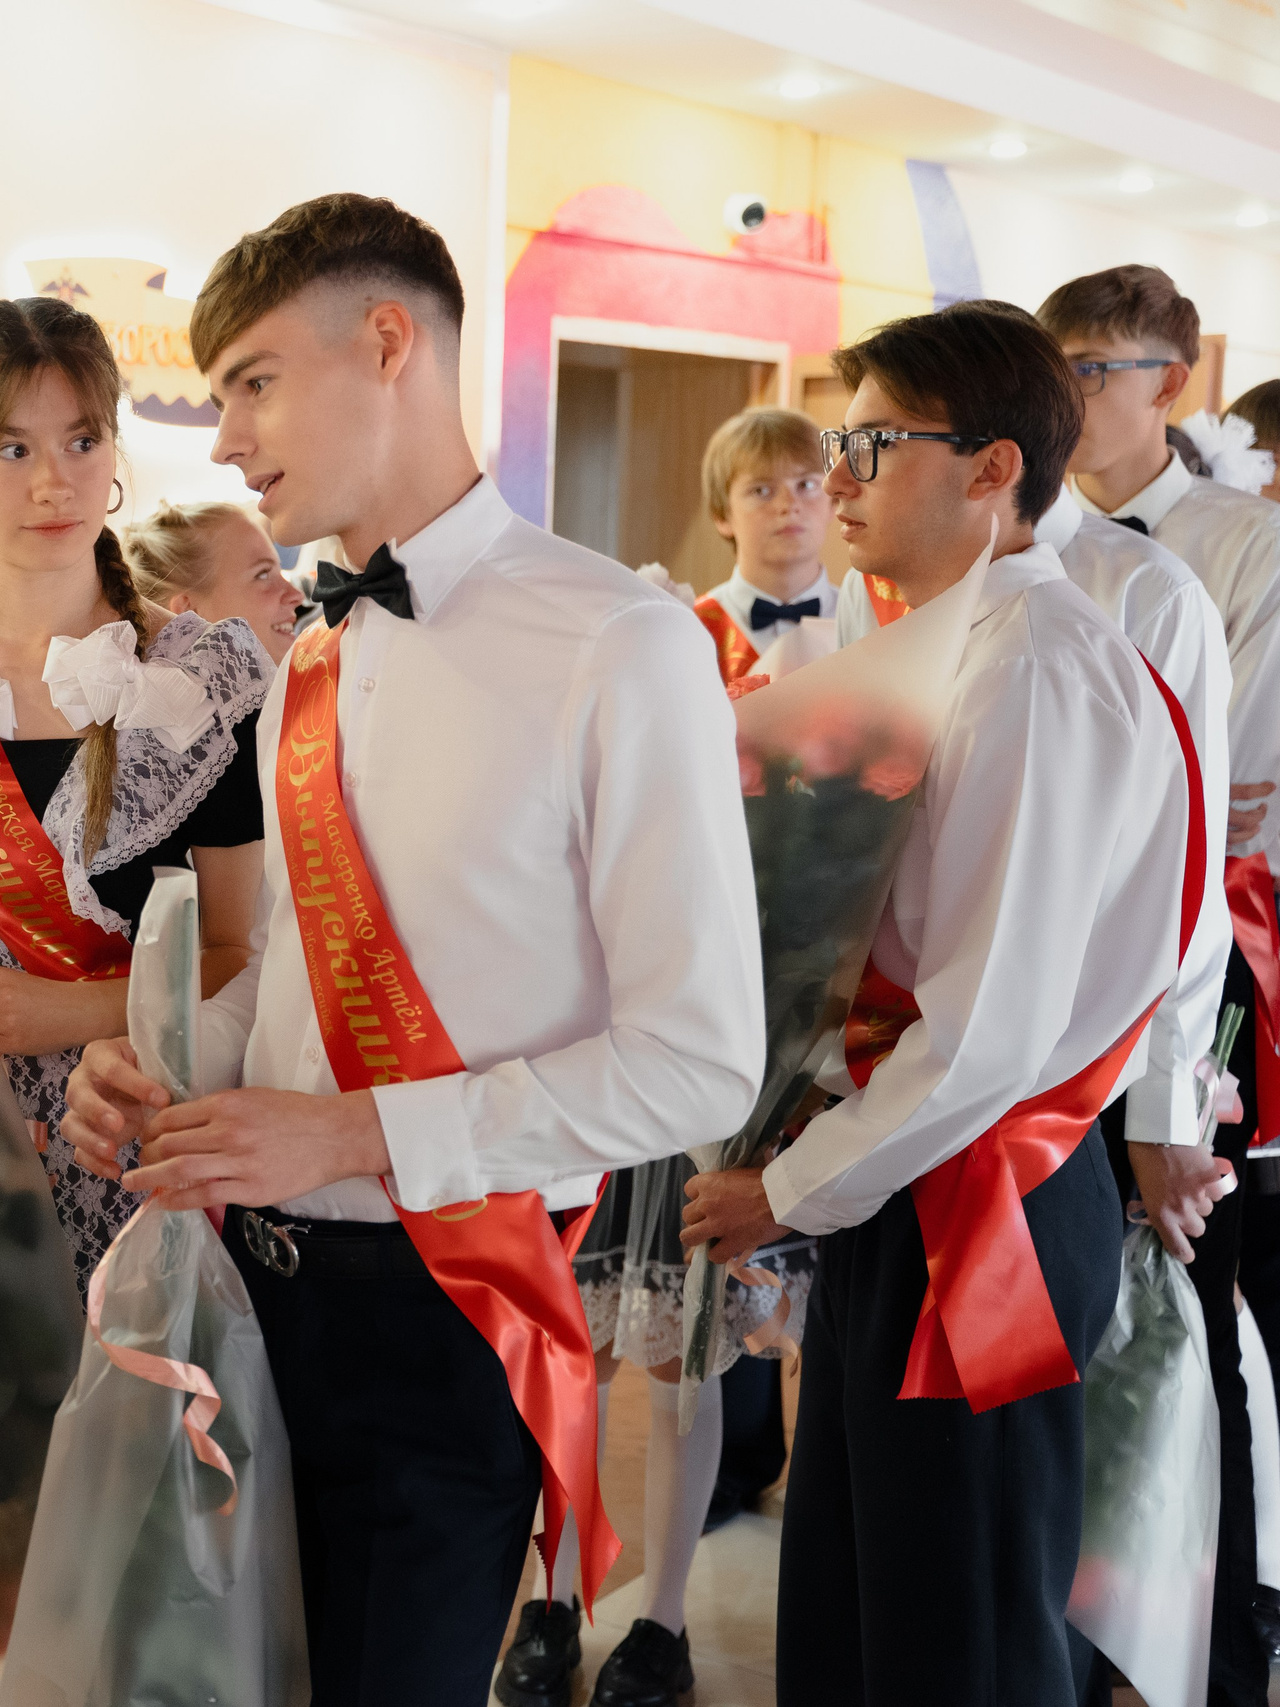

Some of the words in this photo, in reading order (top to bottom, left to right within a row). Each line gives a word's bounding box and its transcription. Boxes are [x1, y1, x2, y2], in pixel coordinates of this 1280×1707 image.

[288, 656, 411, 1084] Выпускник
[321, 792, 377, 940] Макаренко
[363, 946, 428, 1044] Артём
